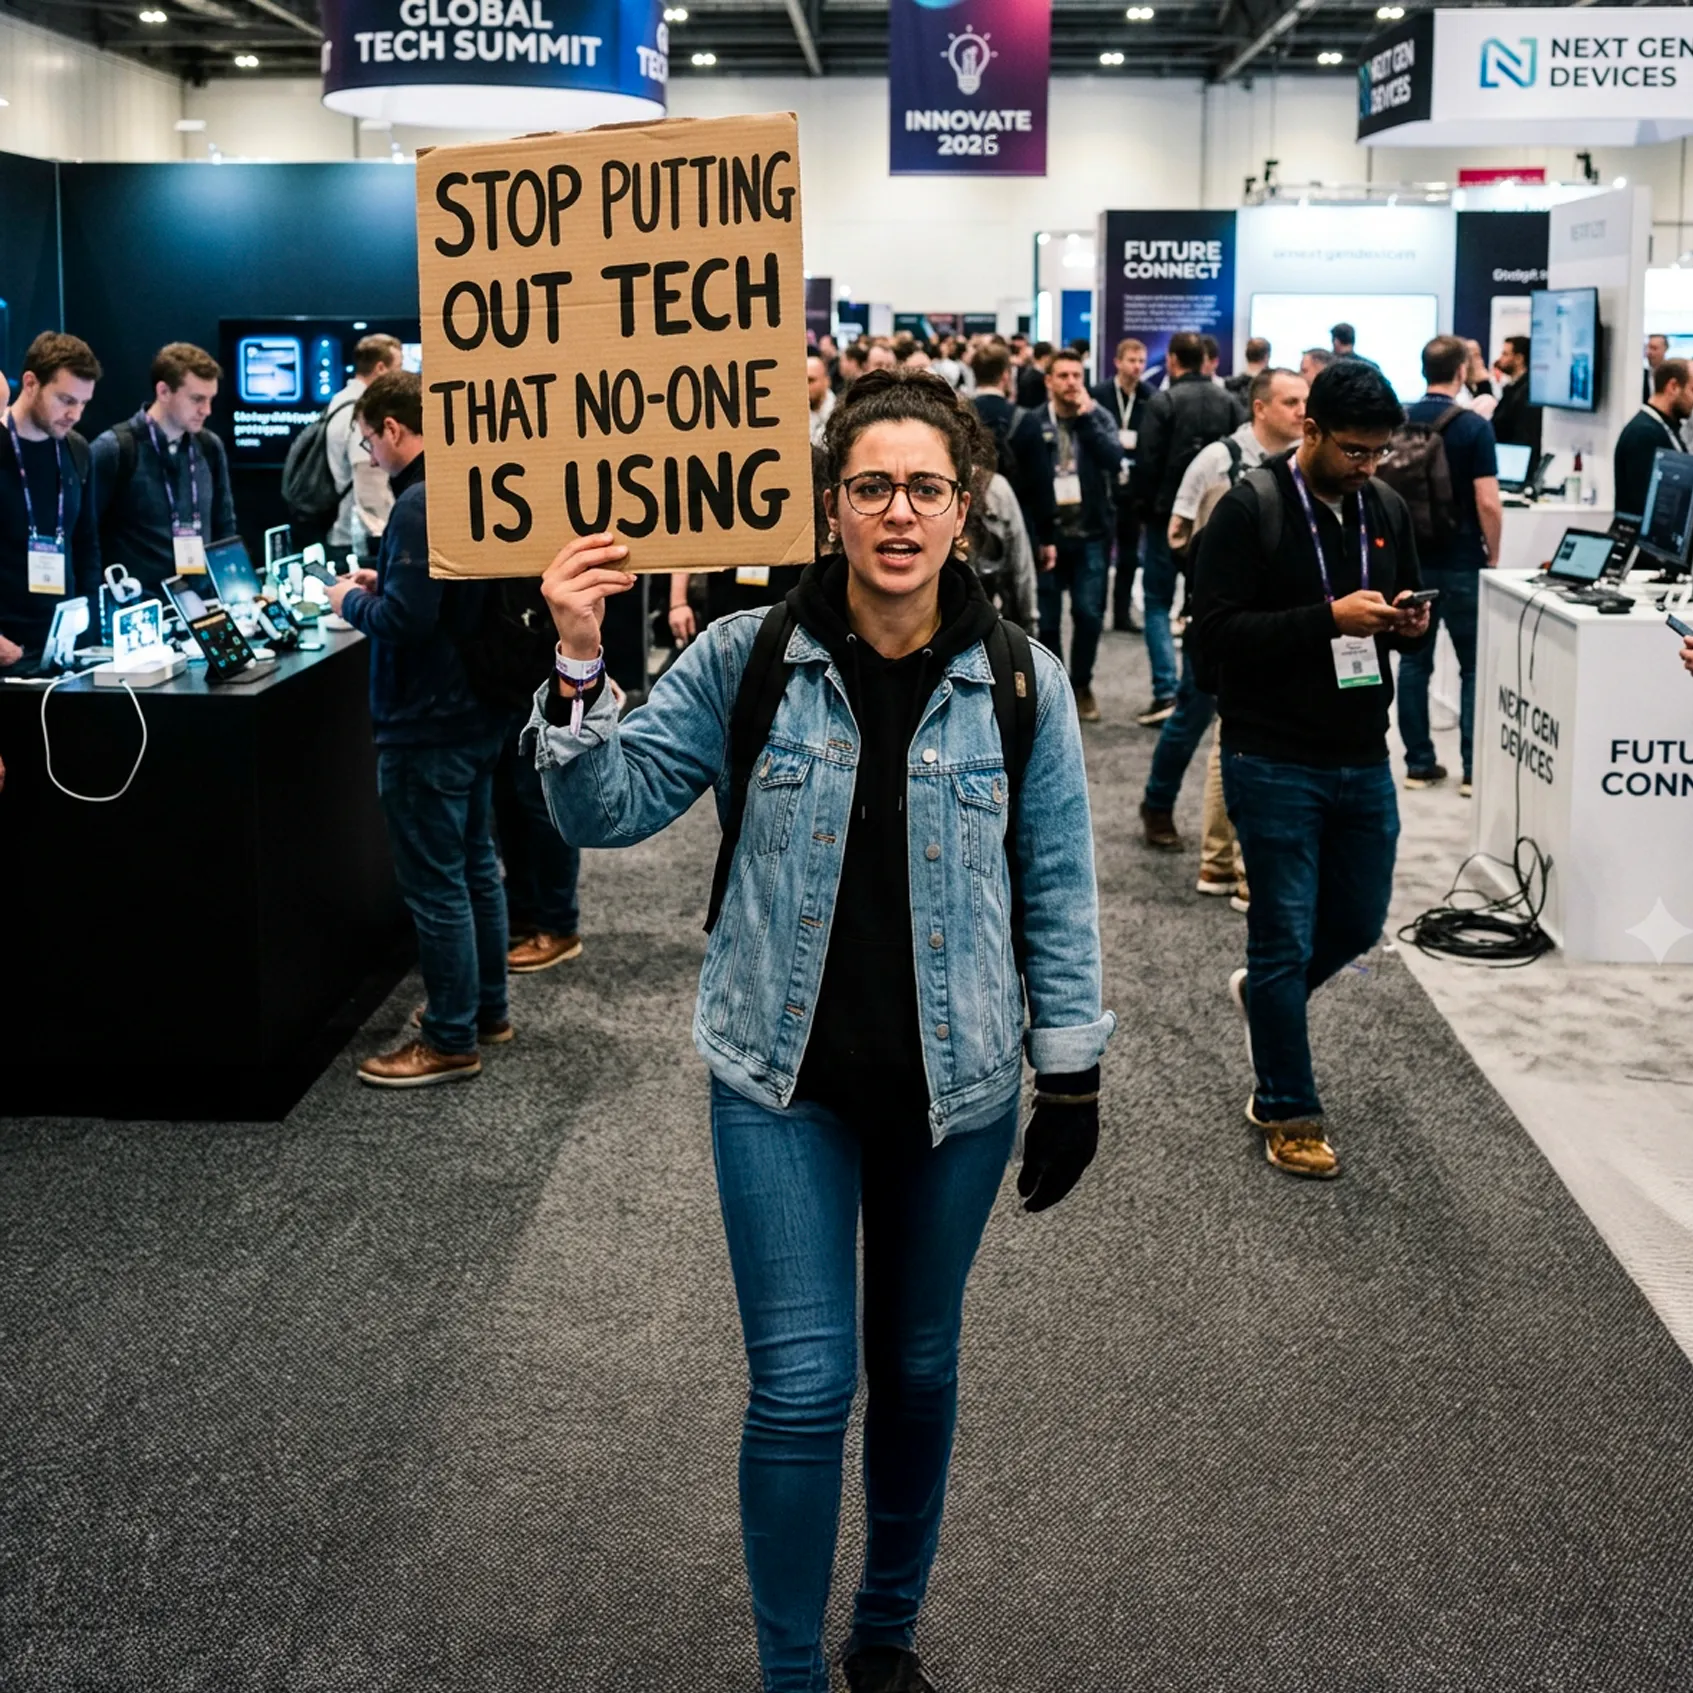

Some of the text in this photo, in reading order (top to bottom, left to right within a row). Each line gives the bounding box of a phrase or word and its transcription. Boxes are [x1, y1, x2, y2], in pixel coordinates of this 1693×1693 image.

[399, 0, 554, 29] GLOBAL
[354, 30, 445, 62] TECH
[453, 29, 603, 67] SUMMIT
[1551, 37, 1693, 58] NEXT GEN
[1550, 65, 1677, 87] DEVICES
[905, 109, 1032, 132] INNOVATE
[937, 134, 999, 156] 2026
[435, 151, 796, 258] STOP PUTTING
[1124, 240, 1222, 261] FUTURE
[1124, 261, 1222, 279] CONNECT
[442, 252, 781, 351] OUT TECH
[429, 359, 780, 446] THAT NO-ONE
[468, 448, 790, 543] IS USING
[1501, 722, 1554, 785] DEVICES
